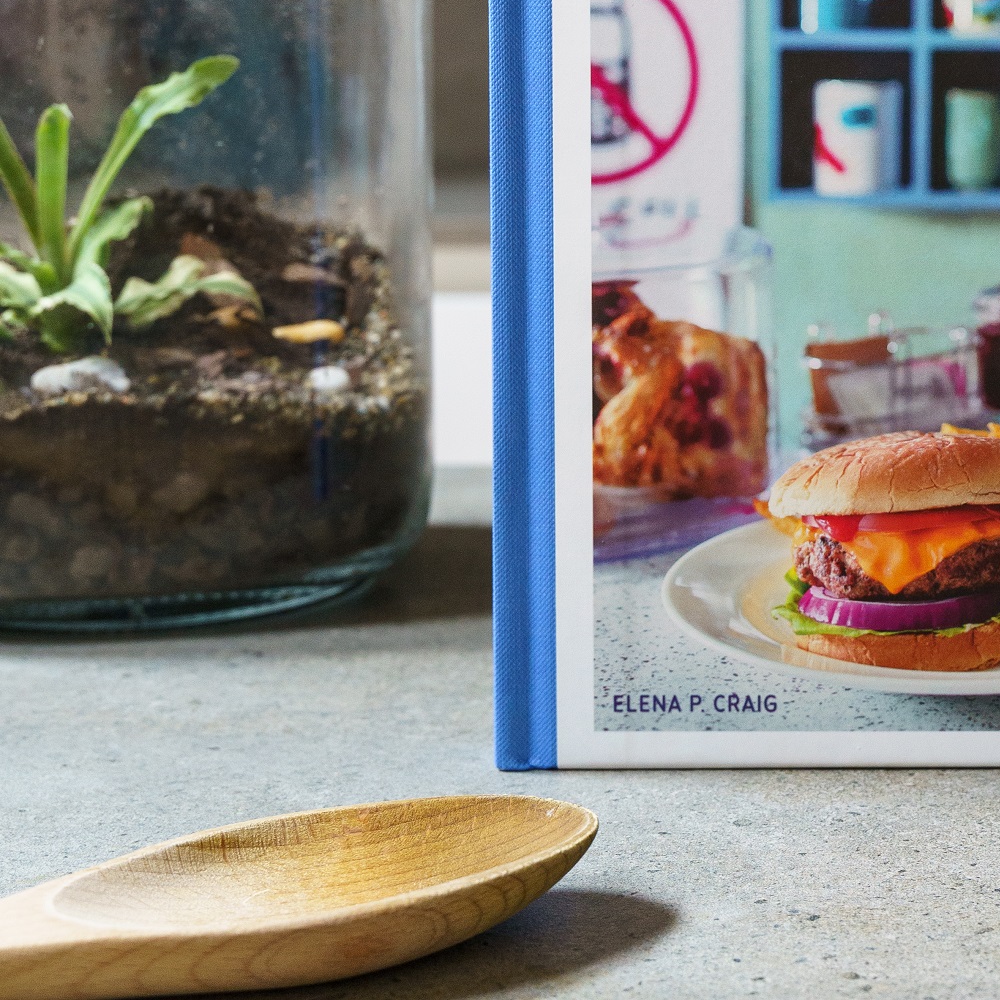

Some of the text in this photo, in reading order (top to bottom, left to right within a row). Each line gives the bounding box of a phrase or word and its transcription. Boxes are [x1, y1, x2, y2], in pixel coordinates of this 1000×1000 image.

[612, 694, 778, 713] ELENA P. CRAIG
